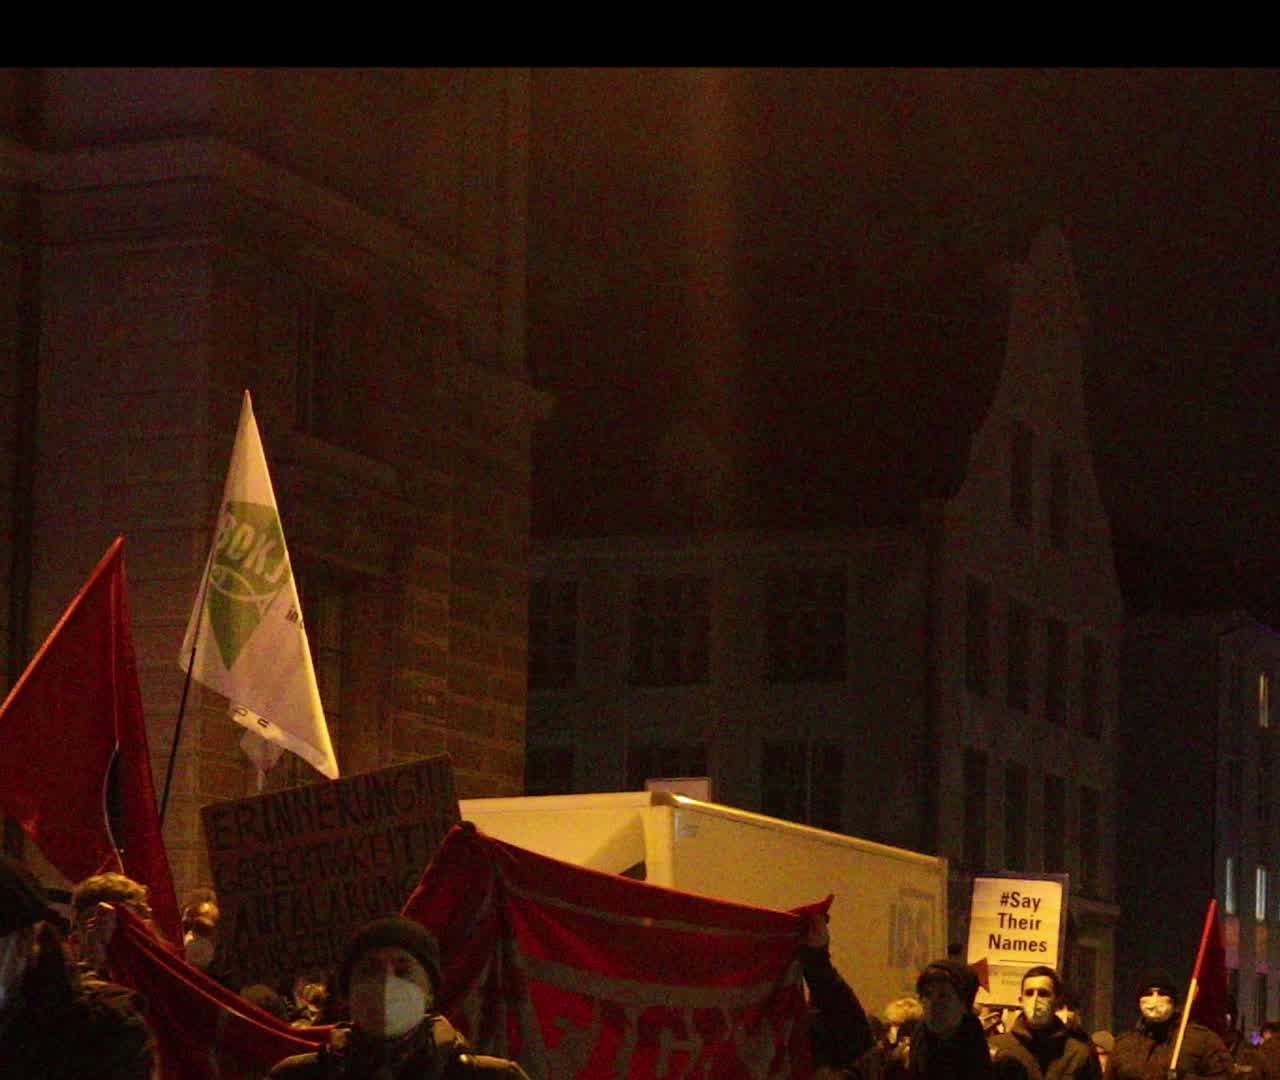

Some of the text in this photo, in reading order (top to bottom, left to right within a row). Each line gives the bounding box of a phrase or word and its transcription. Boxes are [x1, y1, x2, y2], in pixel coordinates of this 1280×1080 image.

[1000, 891, 1041, 912] #Say
[998, 912, 1042, 930] Their
[988, 933, 1048, 952] Names
